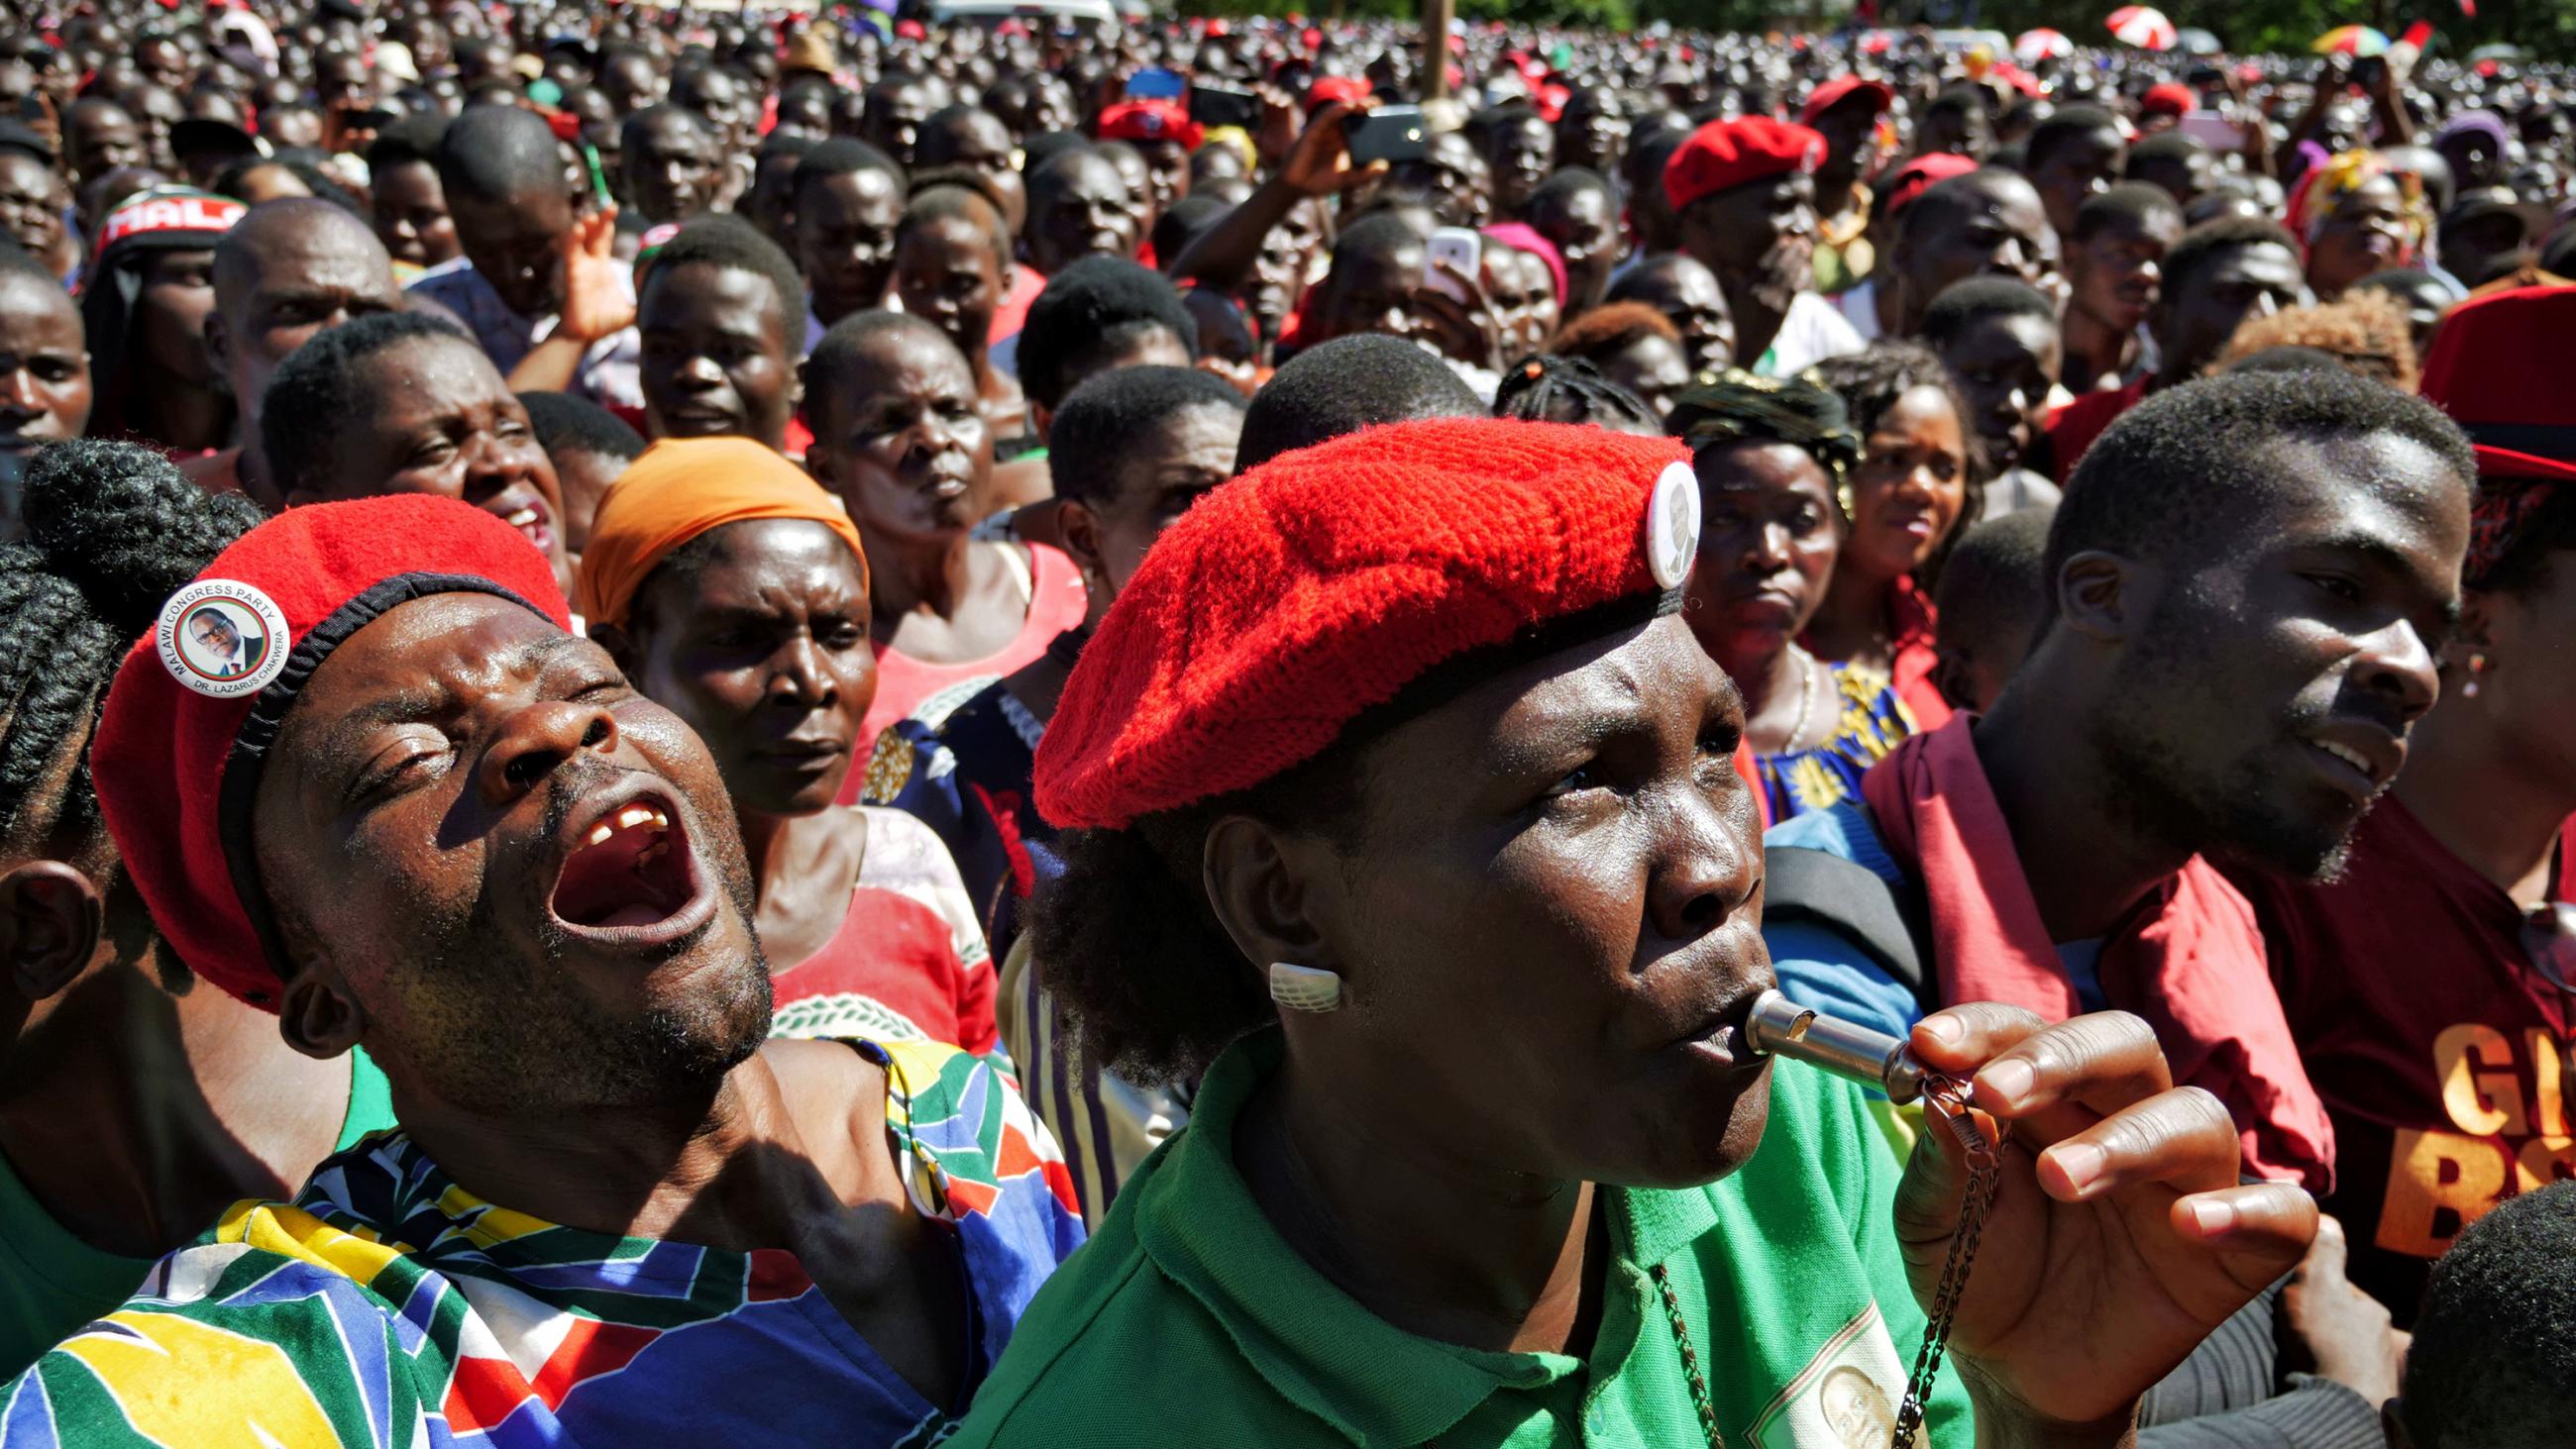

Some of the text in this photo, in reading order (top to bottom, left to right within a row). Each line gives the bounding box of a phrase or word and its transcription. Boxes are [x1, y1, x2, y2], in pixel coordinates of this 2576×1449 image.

[162, 585, 274, 676] MALAWI CONGRESS PARTY
[194, 631, 284, 693] DR. LAZARUS CHAKWERA
